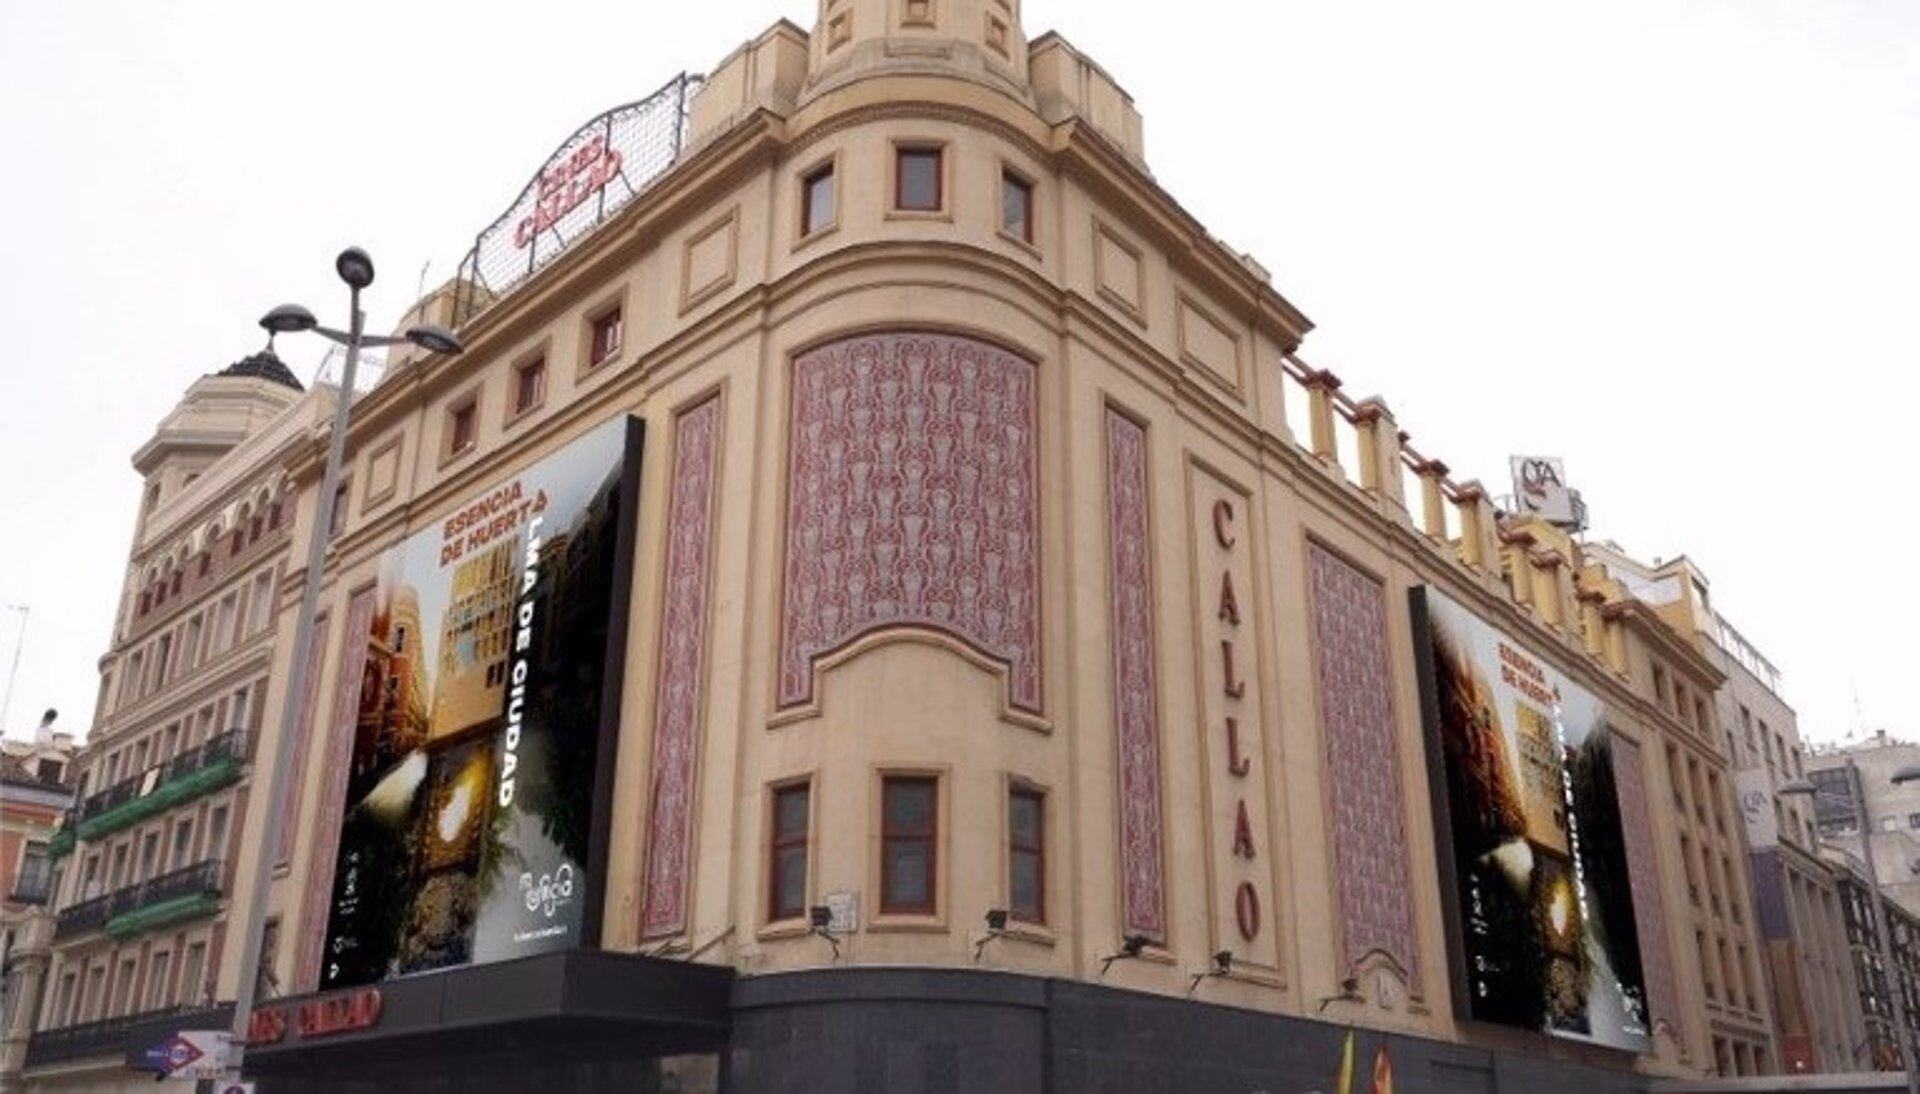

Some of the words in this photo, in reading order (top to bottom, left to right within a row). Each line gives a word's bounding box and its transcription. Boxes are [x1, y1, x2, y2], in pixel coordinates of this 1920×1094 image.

[443, 480, 522, 541] ESENCIA
[440, 537, 464, 568] DE
[516, 600, 535, 652] DE
[499, 659, 528, 807] CIUDAD
[1212, 499, 1261, 944] CALLAO
